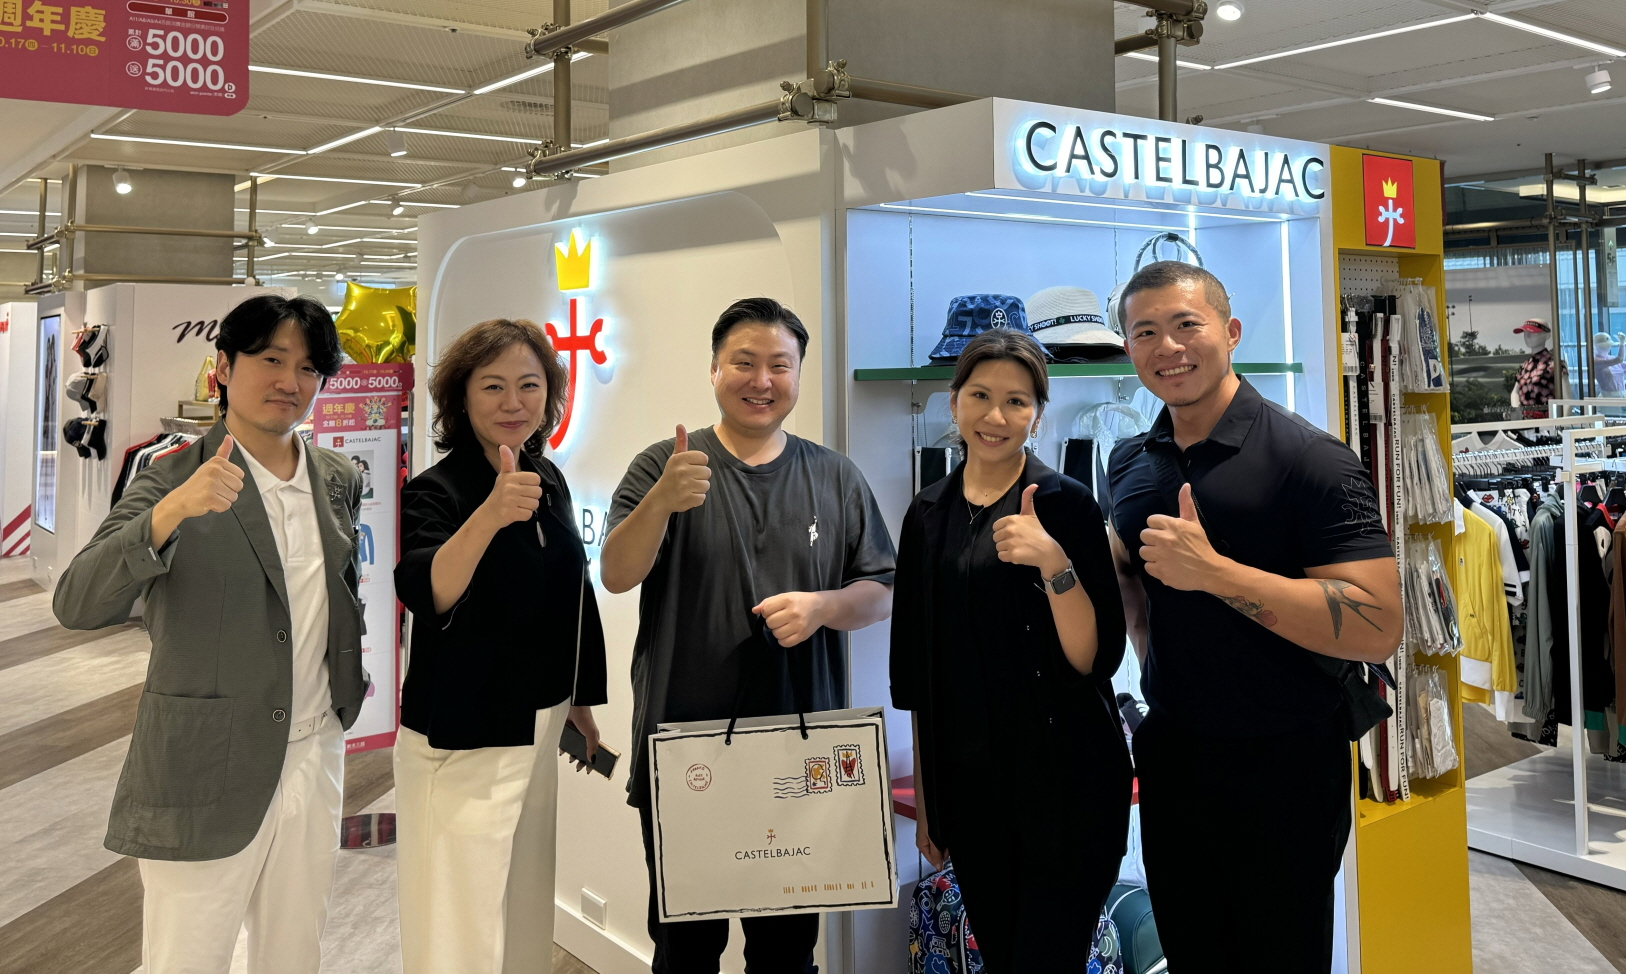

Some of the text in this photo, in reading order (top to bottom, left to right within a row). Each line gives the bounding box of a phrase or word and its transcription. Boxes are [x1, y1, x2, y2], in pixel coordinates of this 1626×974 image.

[0, 0, 106, 42] 週年慶
[145, 29, 225, 61] 5000
[145, 58, 225, 91] 5000
[1025, 121, 1325, 200] CASTELBAJAC
[1034, 319, 1058, 330] SHOOT!
[1070, 314, 1091, 322] LUCKY
[330, 378, 361, 389] 5000
[369, 376, 399, 388] 5000
[323, 403, 356, 414] 週年慶
[1401, 774, 1409, 800] FUN!
[734, 846, 811, 860] CASTELBAJAC
